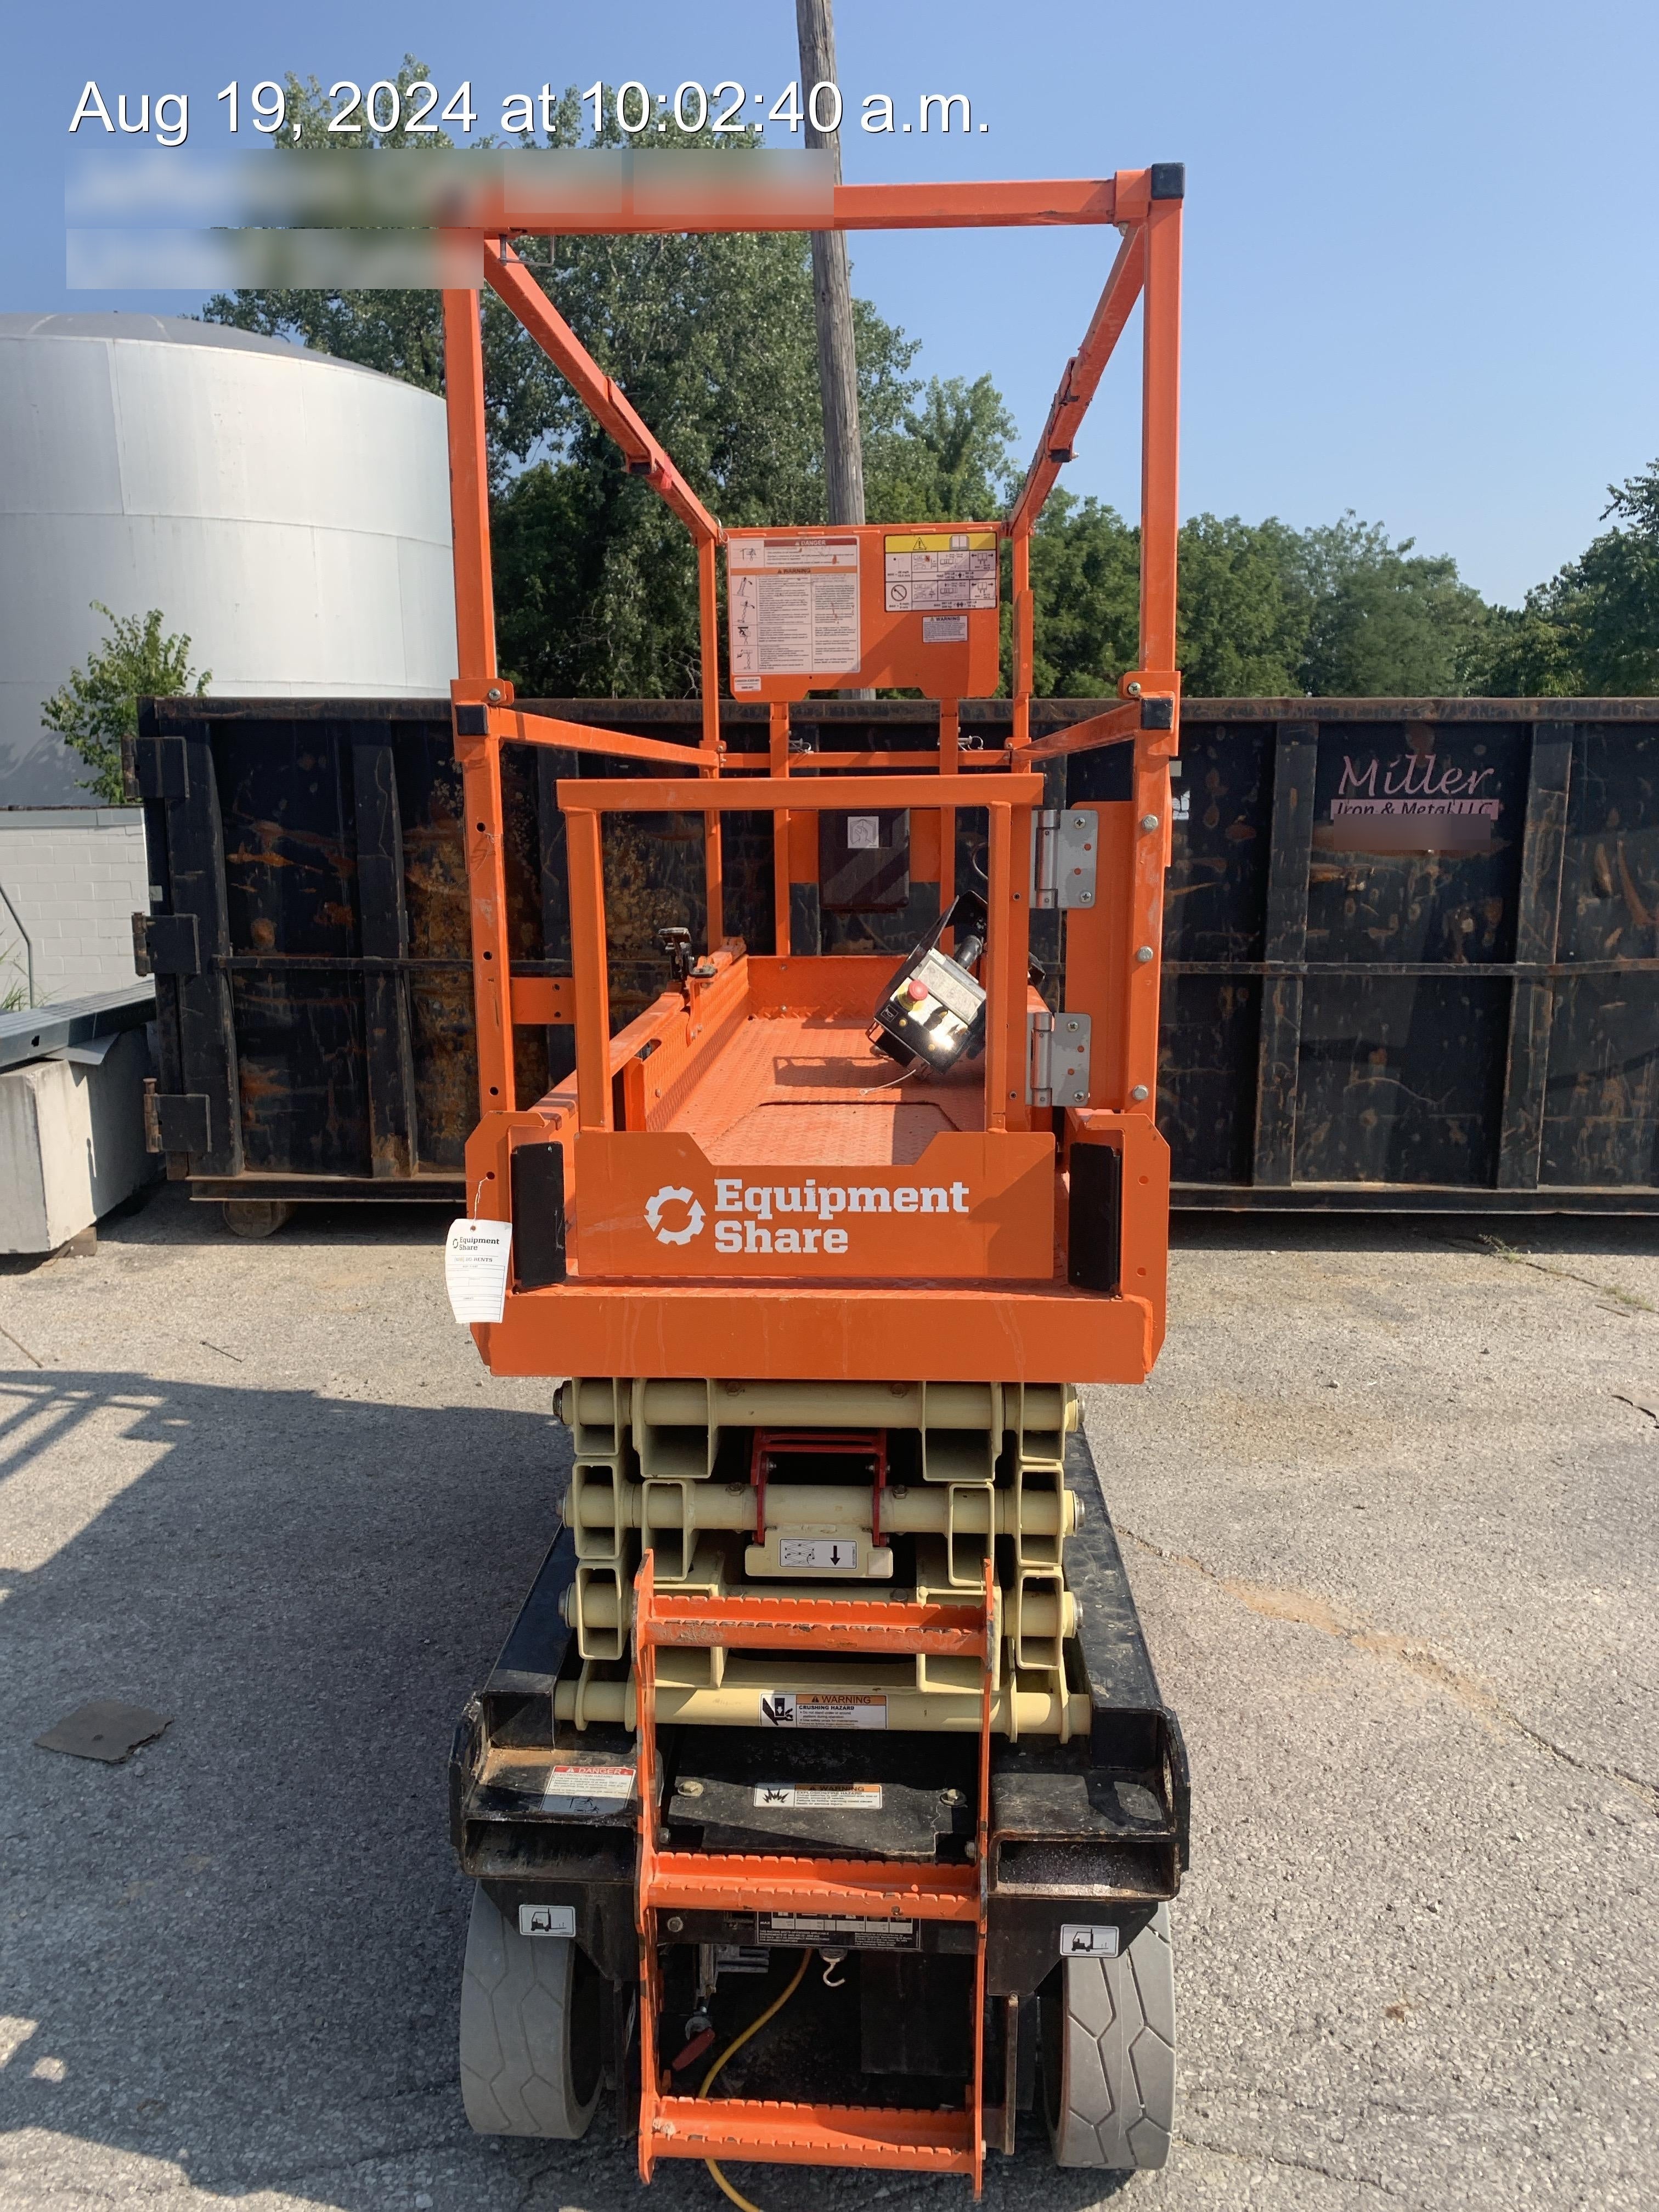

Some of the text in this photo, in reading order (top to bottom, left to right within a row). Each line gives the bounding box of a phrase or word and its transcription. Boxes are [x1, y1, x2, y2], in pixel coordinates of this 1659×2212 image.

[1338, 754, 1495, 797] Miller
[1337, 802, 1374, 814] Iron
[1381, 802, 1394, 814] &
[714, 1179, 969, 1220] Equipment
[715, 1221, 848, 1253] Share
[822, 1695, 871, 1704] WARNING
